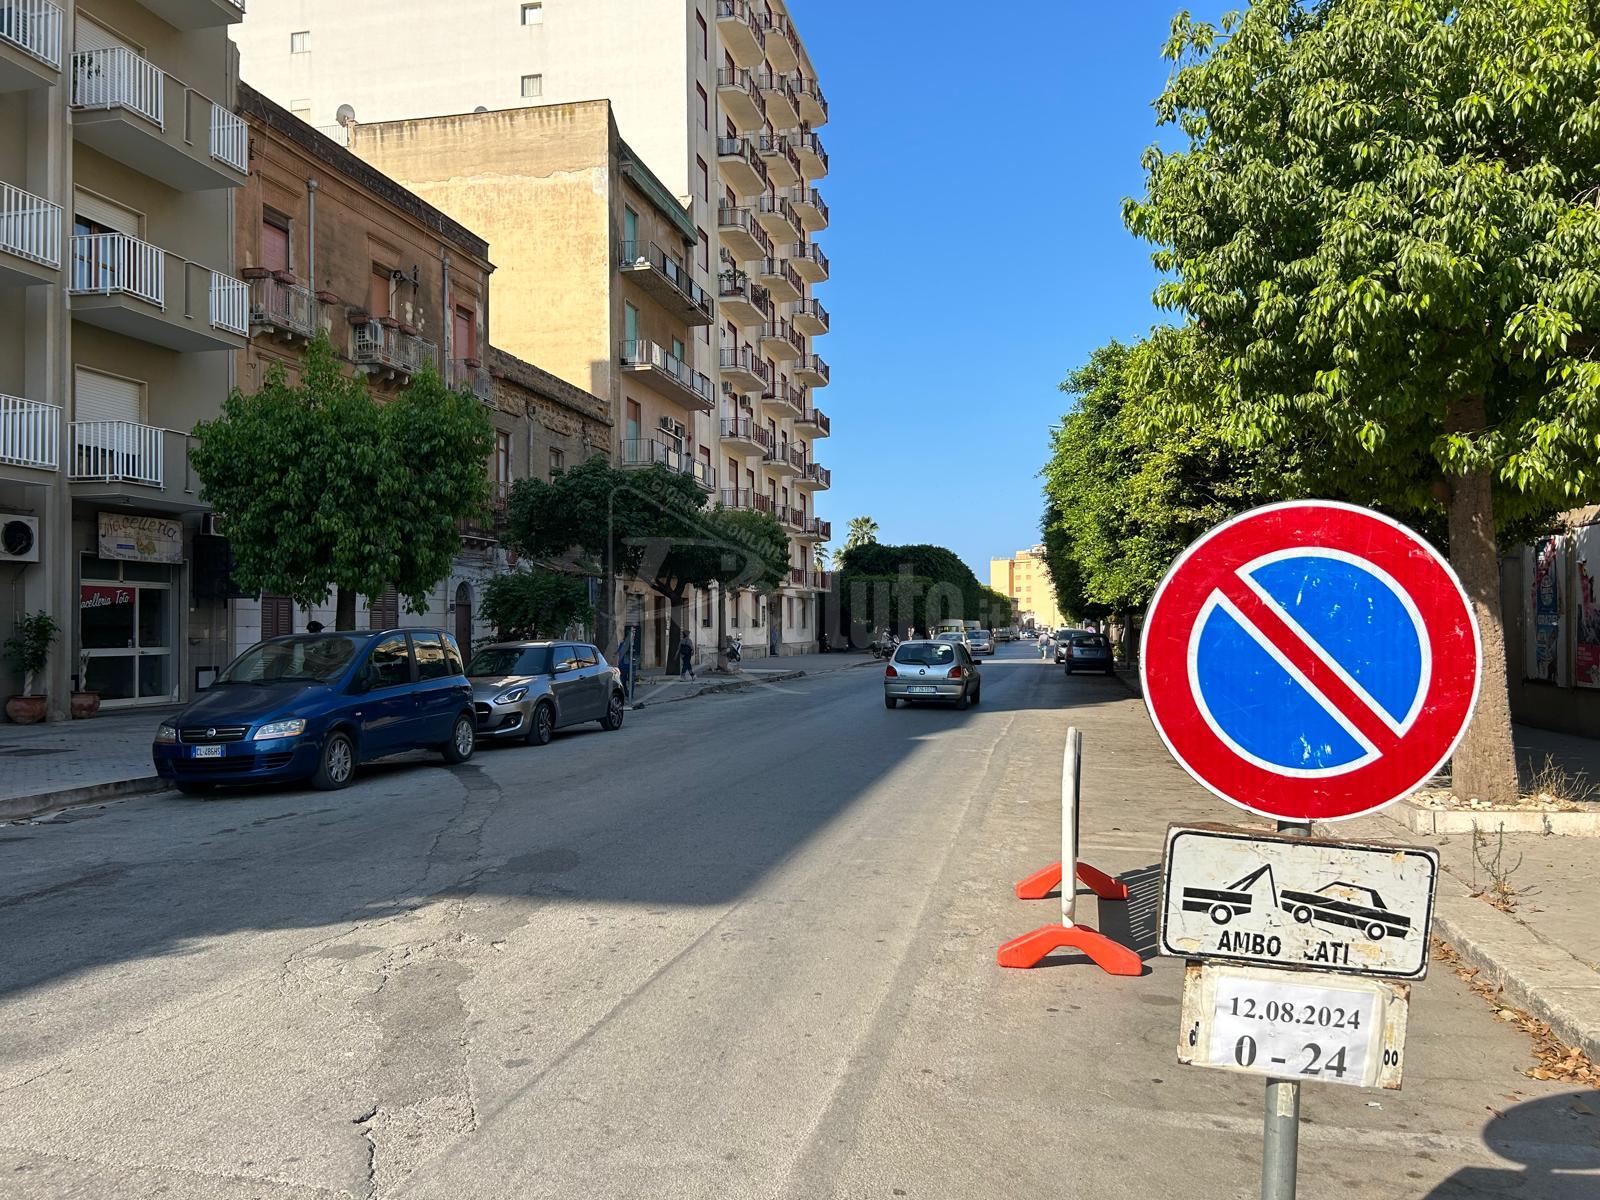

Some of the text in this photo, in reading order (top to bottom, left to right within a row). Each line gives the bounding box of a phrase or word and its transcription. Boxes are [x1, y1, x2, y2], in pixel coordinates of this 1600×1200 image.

[80, 592, 112, 608] acelleria
[1217, 930, 1282, 957] AMBO
[1229, 996, 1360, 1030] 12.08.2024
[1235, 1034, 1257, 1067] 0
[1299, 1042, 1347, 1078] 24
